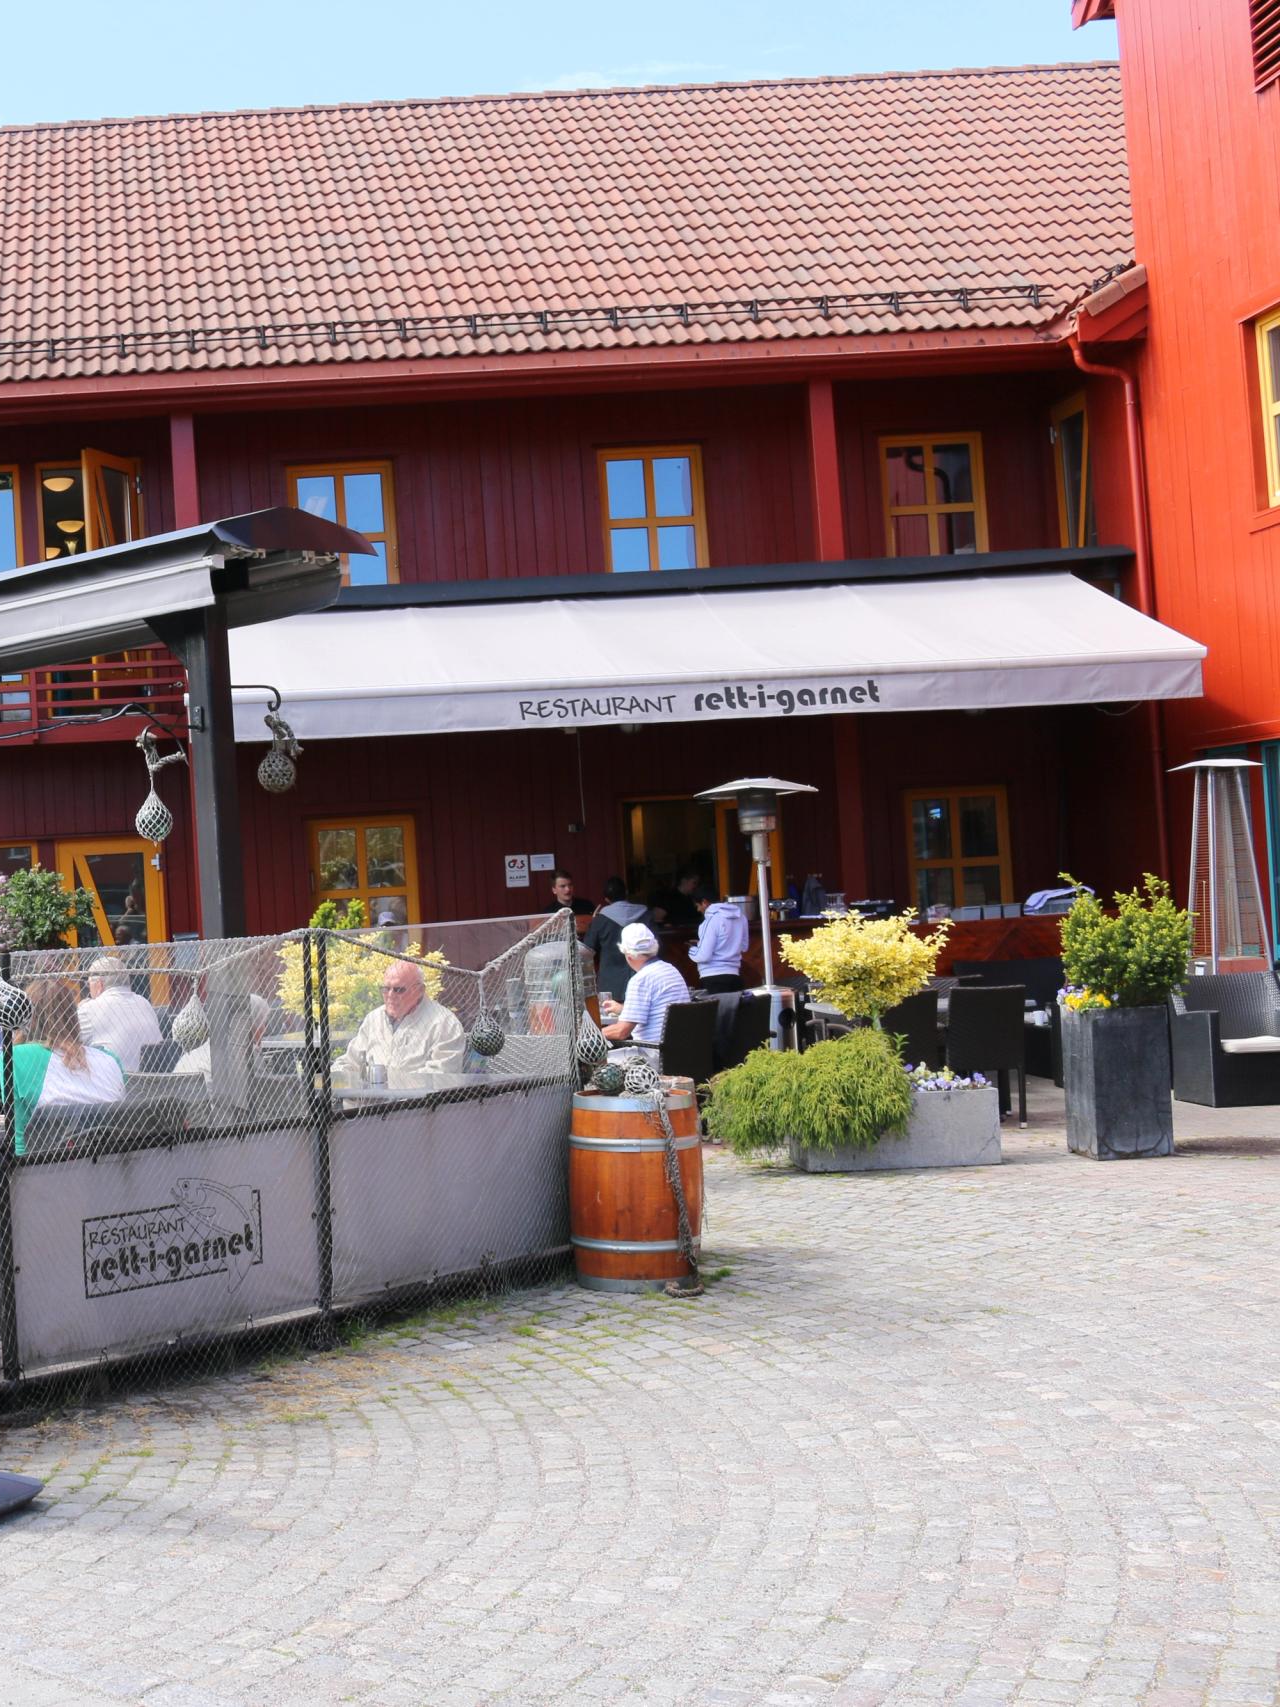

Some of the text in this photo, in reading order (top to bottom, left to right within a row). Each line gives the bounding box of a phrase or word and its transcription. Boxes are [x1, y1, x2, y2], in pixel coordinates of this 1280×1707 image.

[519, 679, 880, 720] RESTAURANT rett-i-garnet
[89, 1217, 186, 1249] RESTAURANT
[90, 1223, 254, 1283] rett-i-garnet
